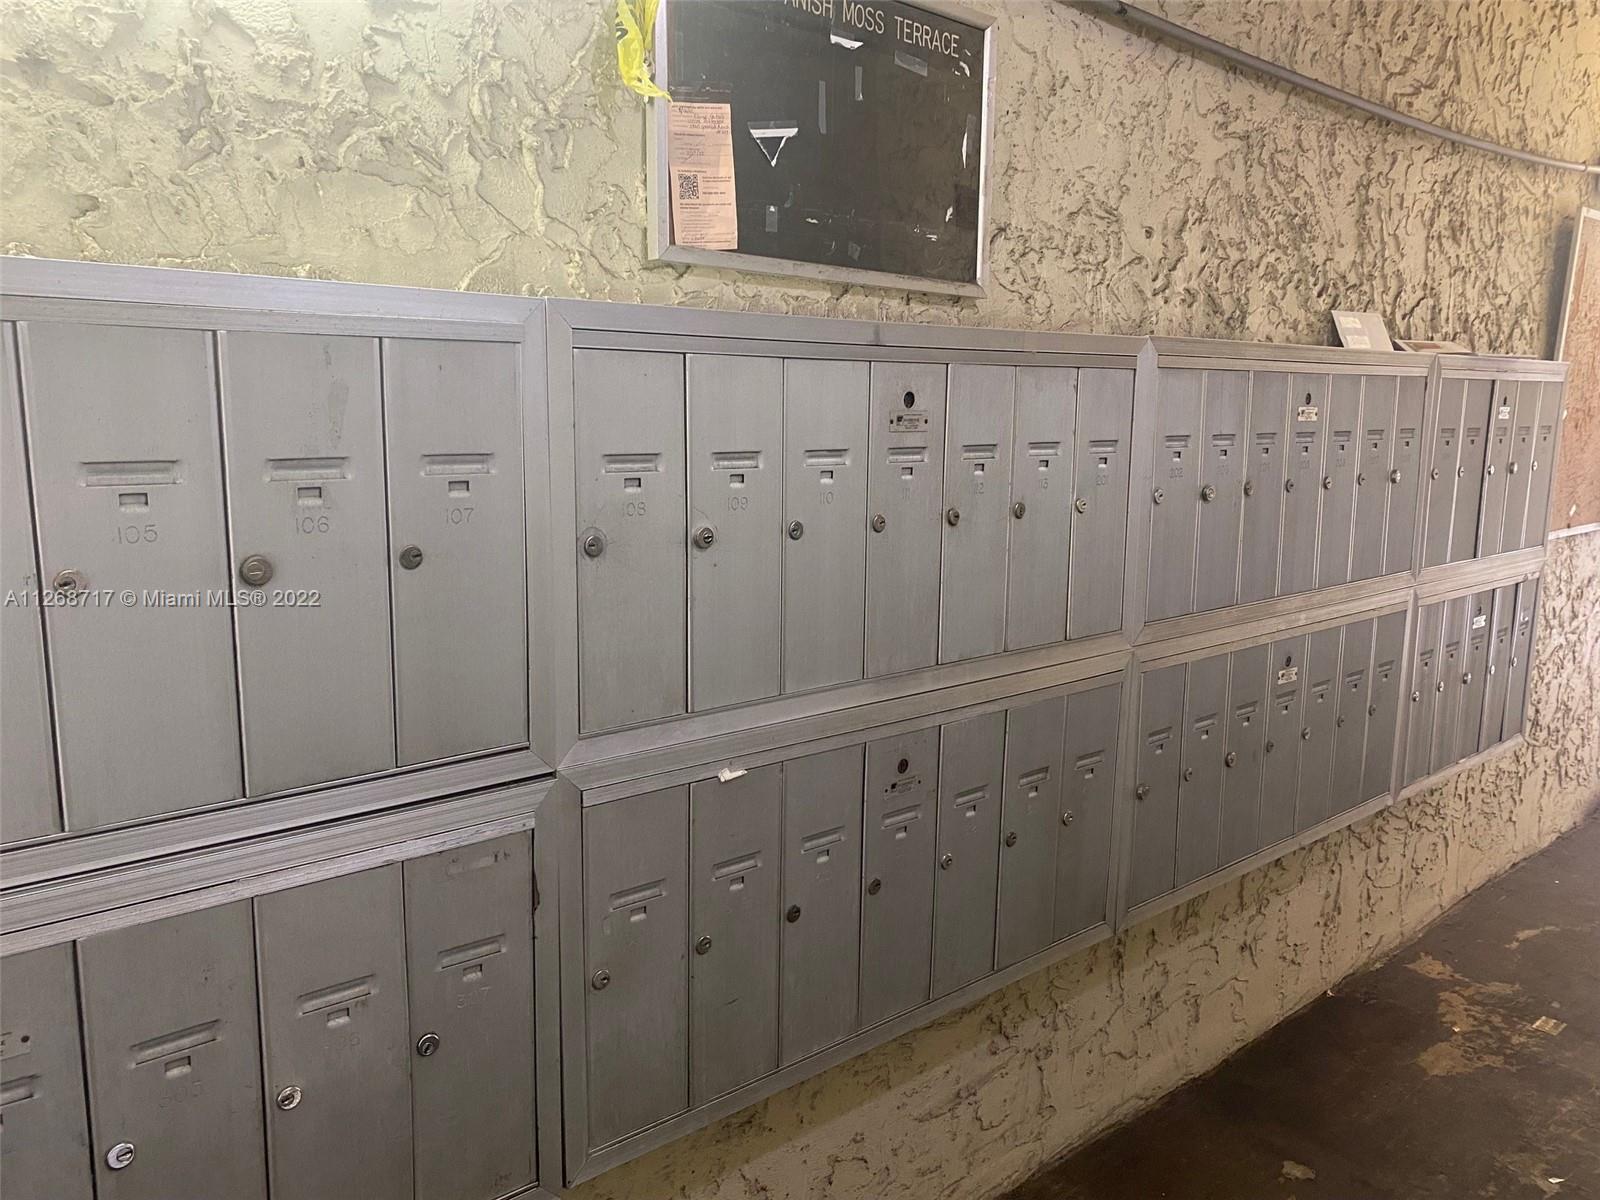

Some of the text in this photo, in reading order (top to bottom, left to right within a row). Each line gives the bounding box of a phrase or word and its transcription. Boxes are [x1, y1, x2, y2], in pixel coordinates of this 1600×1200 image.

[842, 1, 886, 34] MOSS
[894, 16, 959, 58] TERRACE
[727, 495, 748, 511] 109
[295, 516, 330, 535] 106
[445, 507, 475, 526] 107
[117, 524, 158, 544] 105
